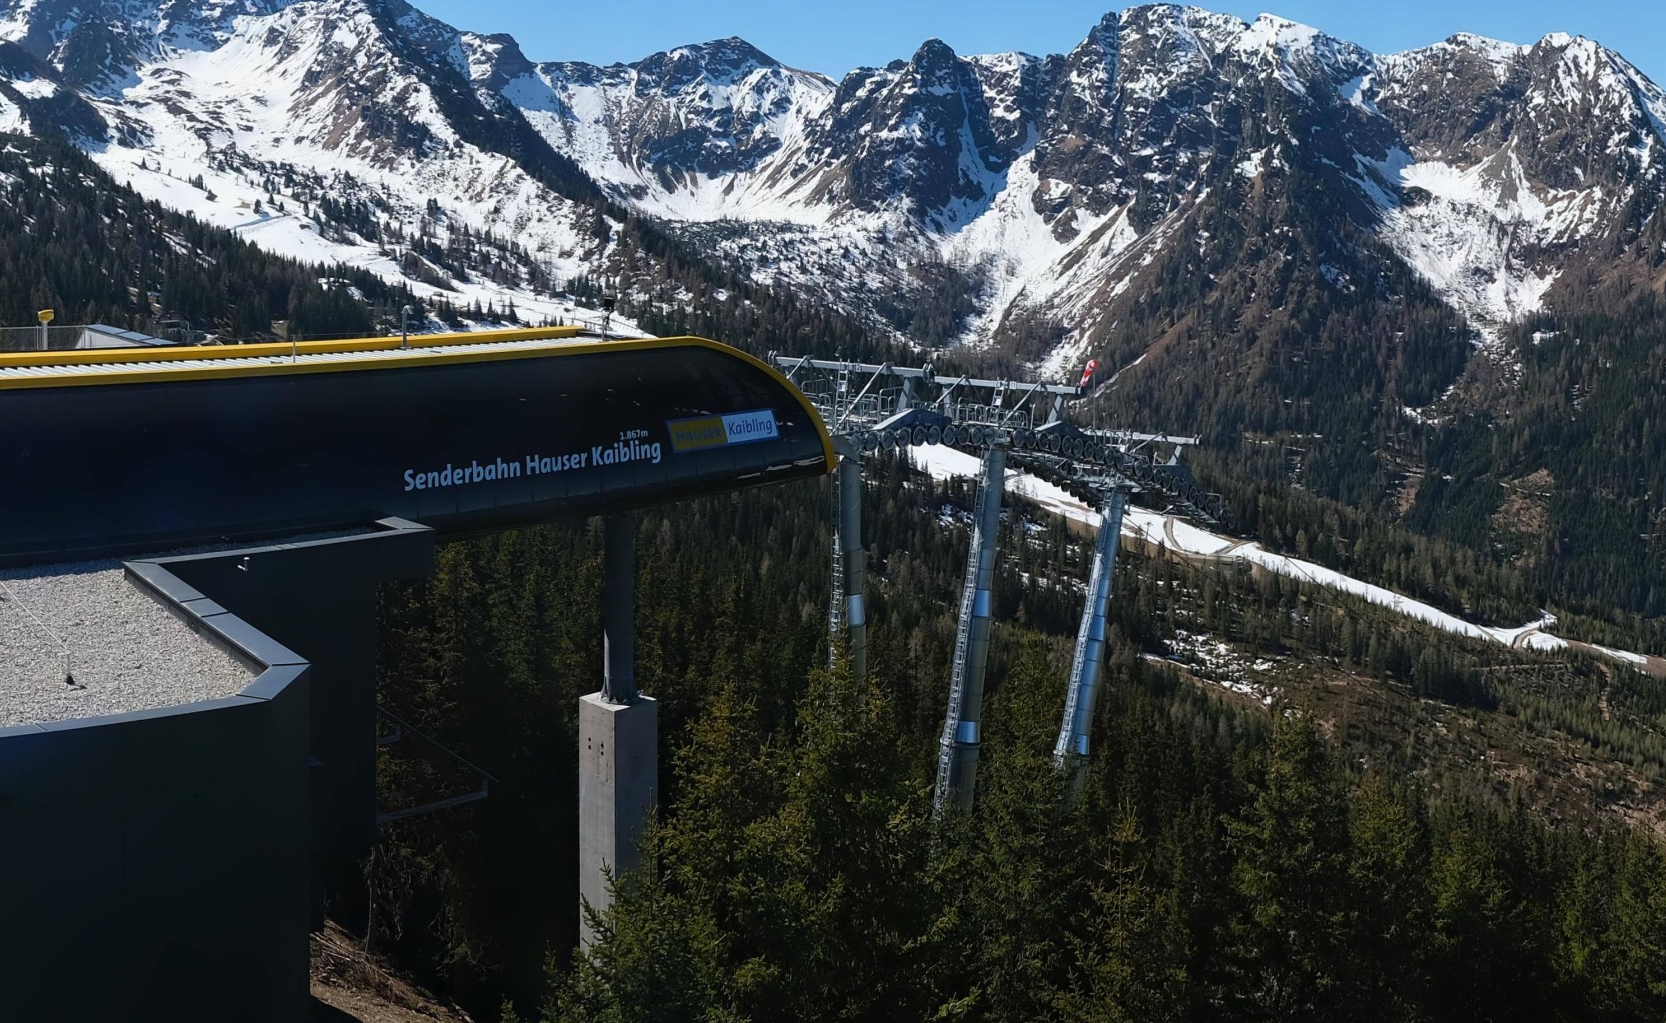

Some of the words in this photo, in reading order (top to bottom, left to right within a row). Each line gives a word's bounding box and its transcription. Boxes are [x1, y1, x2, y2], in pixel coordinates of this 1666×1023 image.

[619, 429, 649, 440] 1.867m
[728, 418, 773, 436] Kaibling
[404, 457, 521, 491] Senderbahn
[526, 450, 588, 476] Hauser
[592, 438, 662, 466] Kaibling
